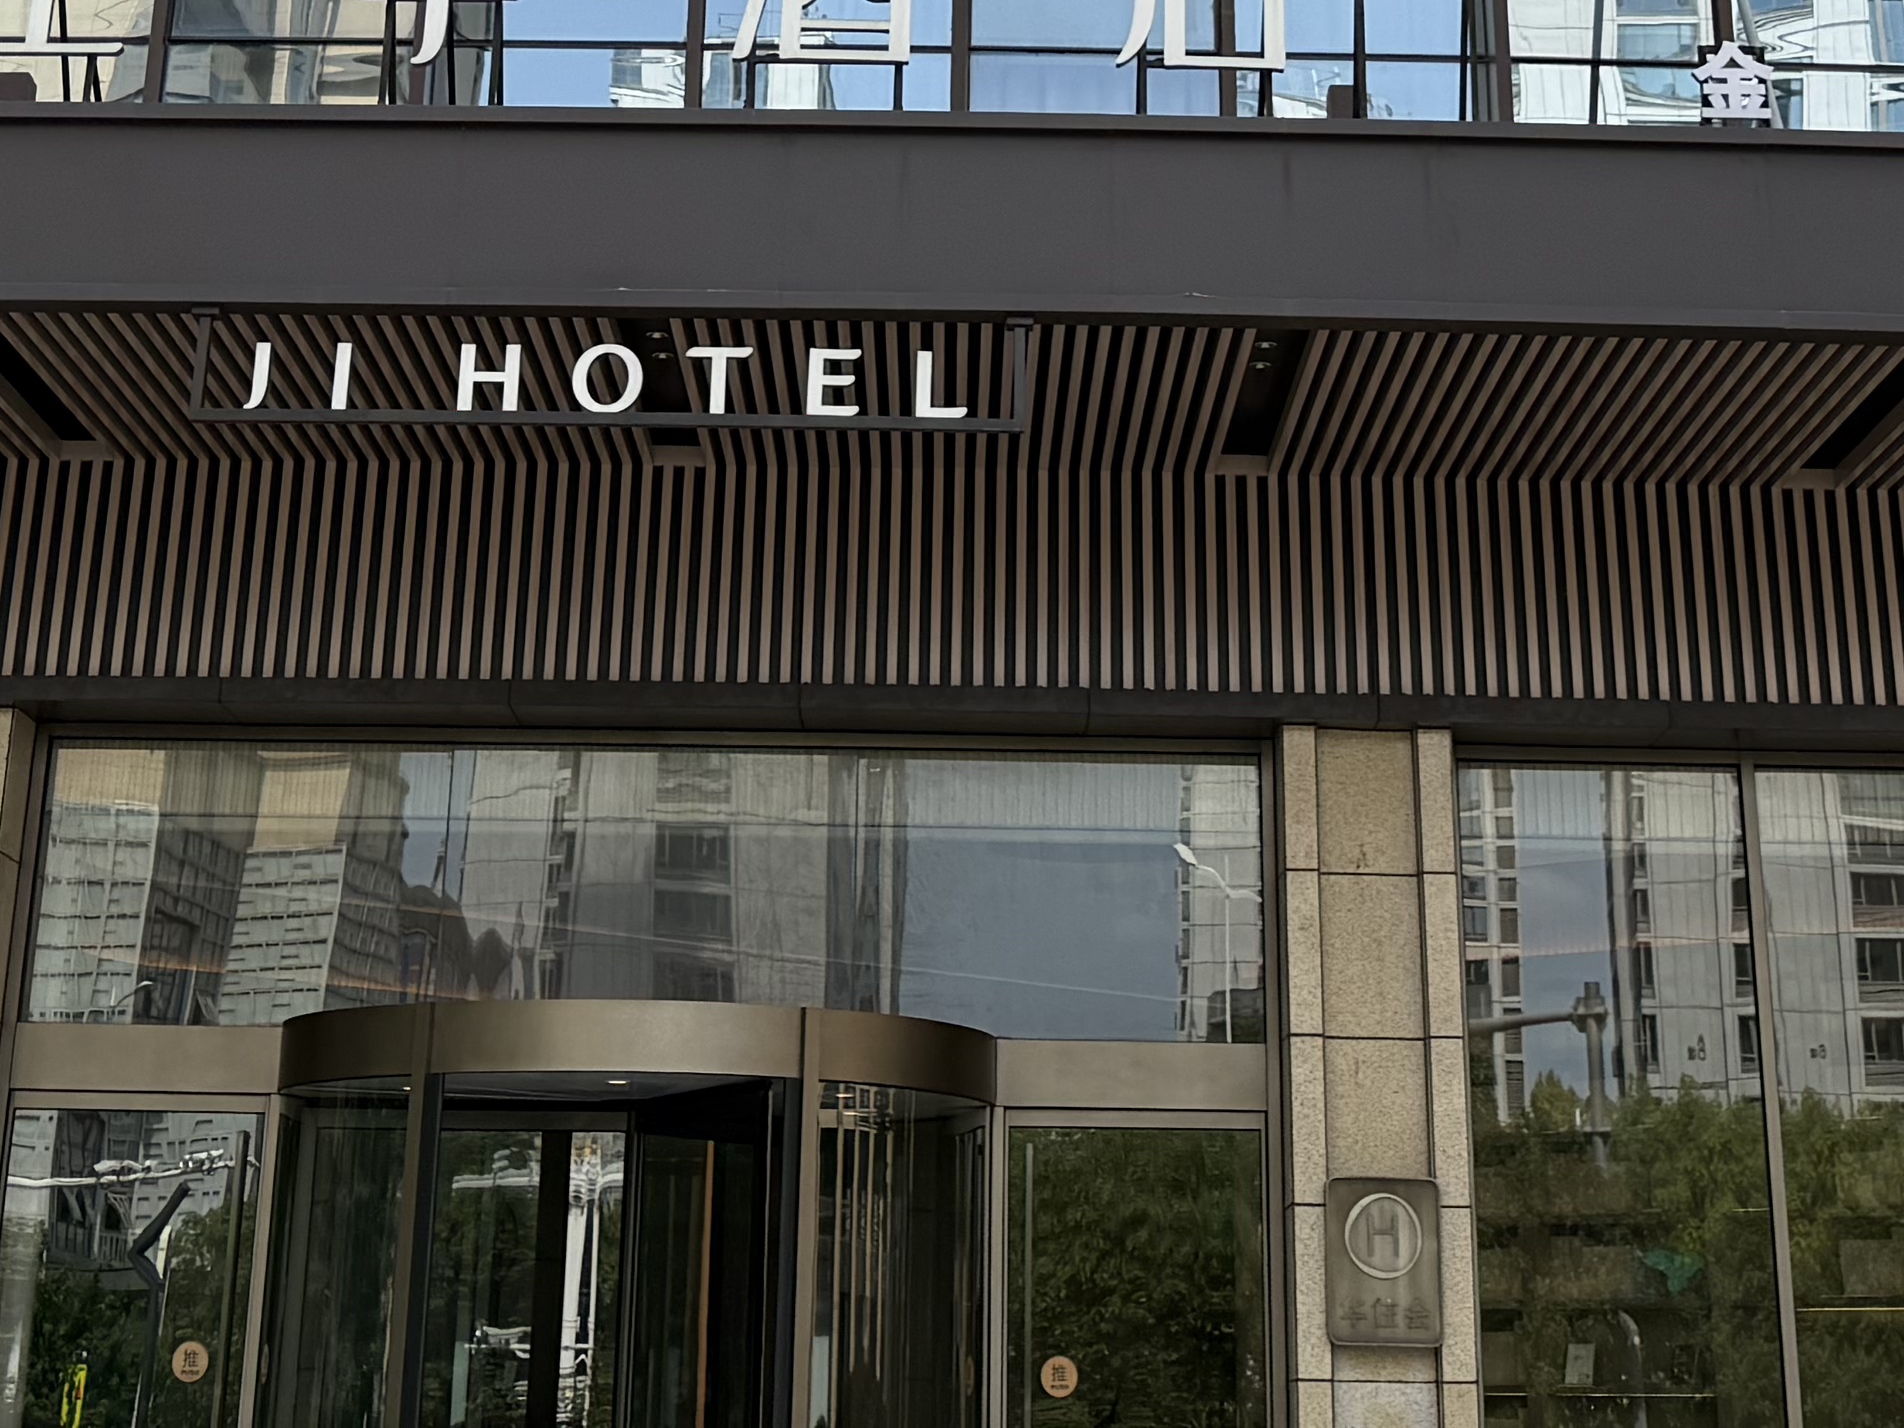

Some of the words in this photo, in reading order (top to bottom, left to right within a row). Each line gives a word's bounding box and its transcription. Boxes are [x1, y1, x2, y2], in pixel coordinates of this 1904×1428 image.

[242, 341, 353, 411] JI
[456, 343, 969, 419] HOTEL
[1340, 1297, 1431, 1331] 华住会
